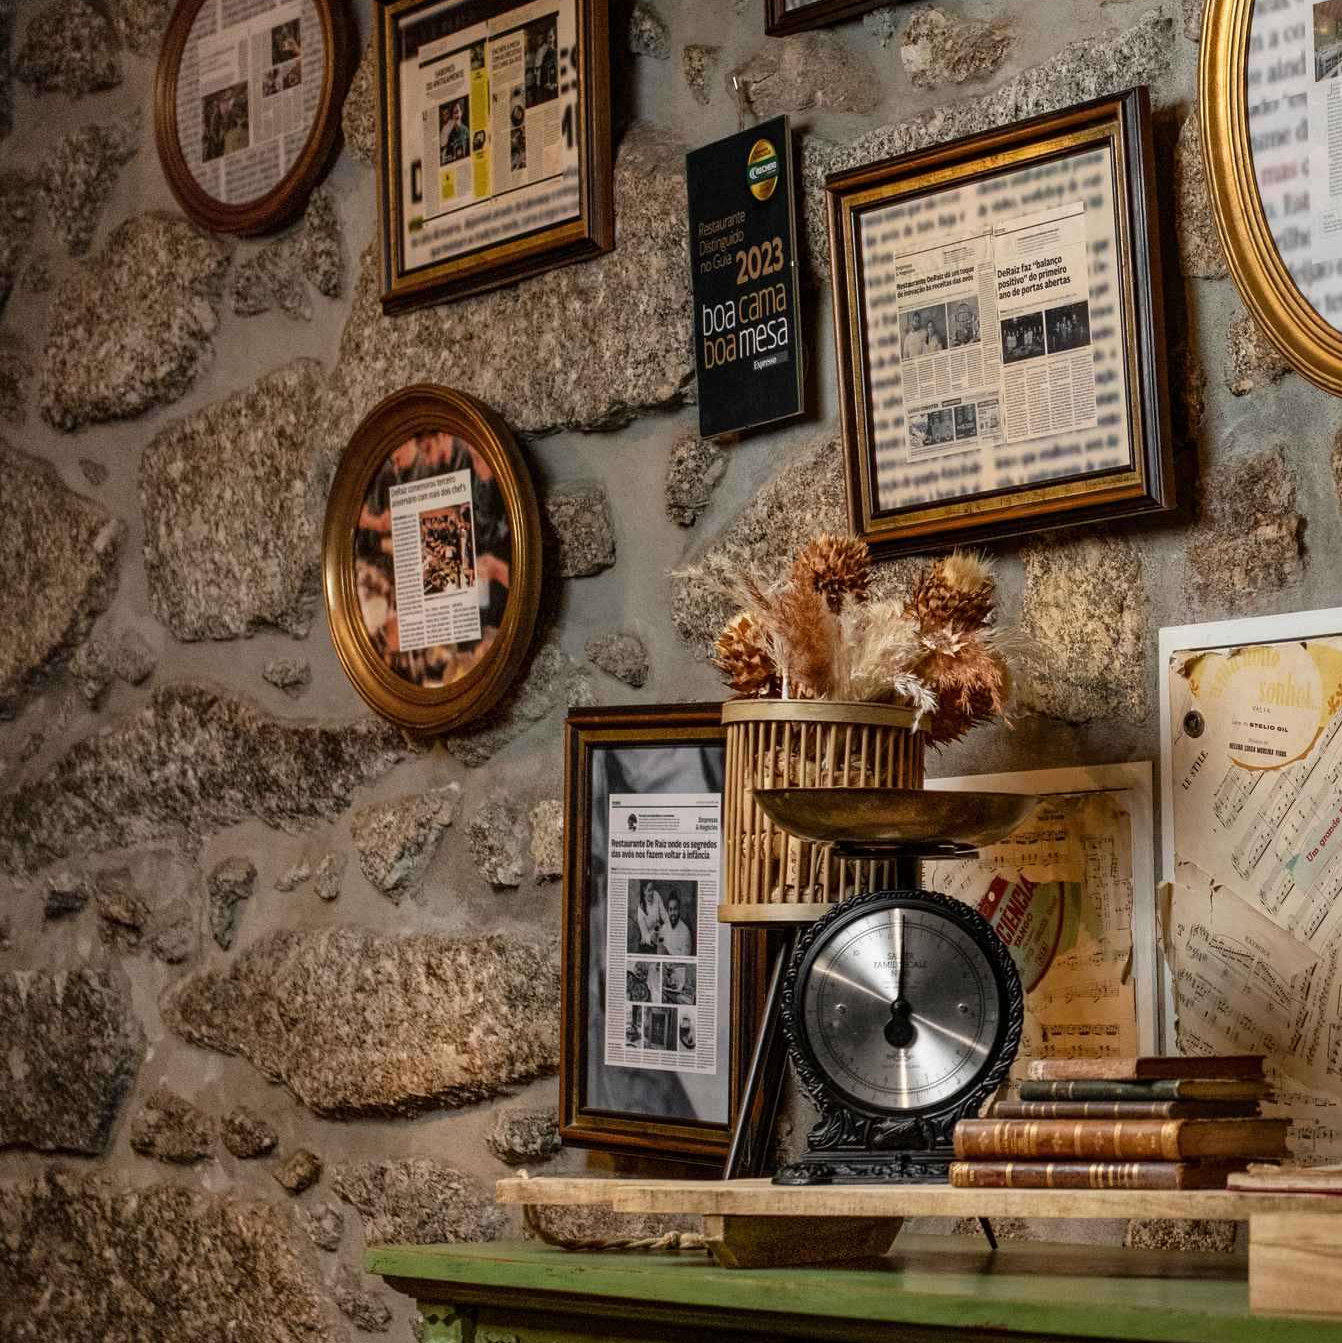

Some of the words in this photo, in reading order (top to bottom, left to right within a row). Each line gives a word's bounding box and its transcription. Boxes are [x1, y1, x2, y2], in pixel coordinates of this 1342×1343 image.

[698, 211, 746, 236] Restaurante
[699, 228, 745, 256] Distinguido
[713, 253, 732, 270] Guia
[736, 236, 784, 286] 2023
[997, 266, 1020, 279] DeRaiz
[1021, 263, 1033, 273] faz
[1028, 272, 1037, 282] do
[1038, 265, 1068, 282] primeiro
[896, 278, 926, 290] Restaurante
[998, 290, 1012, 300] ano
[1011, 287, 1021, 297] de
[1021, 282, 1044, 297] portas
[1044, 276, 1071, 289] abertas
[702, 300, 736, 336] boa
[739, 282, 787, 324] cama
[703, 333, 737, 370] boa
[739, 316, 788, 359] mesa
[611, 839, 646, 849] Restaurante
[646, 839, 654, 849] De
[654, 839, 667, 849] Raiz
[667, 839, 682, 849] onde
[682, 841, 690, 849] os
[690, 839, 718, 851] segredos
[1305, 847, 1320, 862] Um
[1319, 817, 1341, 847] grande
[611, 849, 622, 858] das
[621, 849, 635, 859] avós
[635, 851, 645, 859] nos
[646, 849, 664, 859] fazem
[664, 849, 682, 859] voltar
[686, 849, 711, 860] infância
[1014, 912, 1033, 947] TANGO
